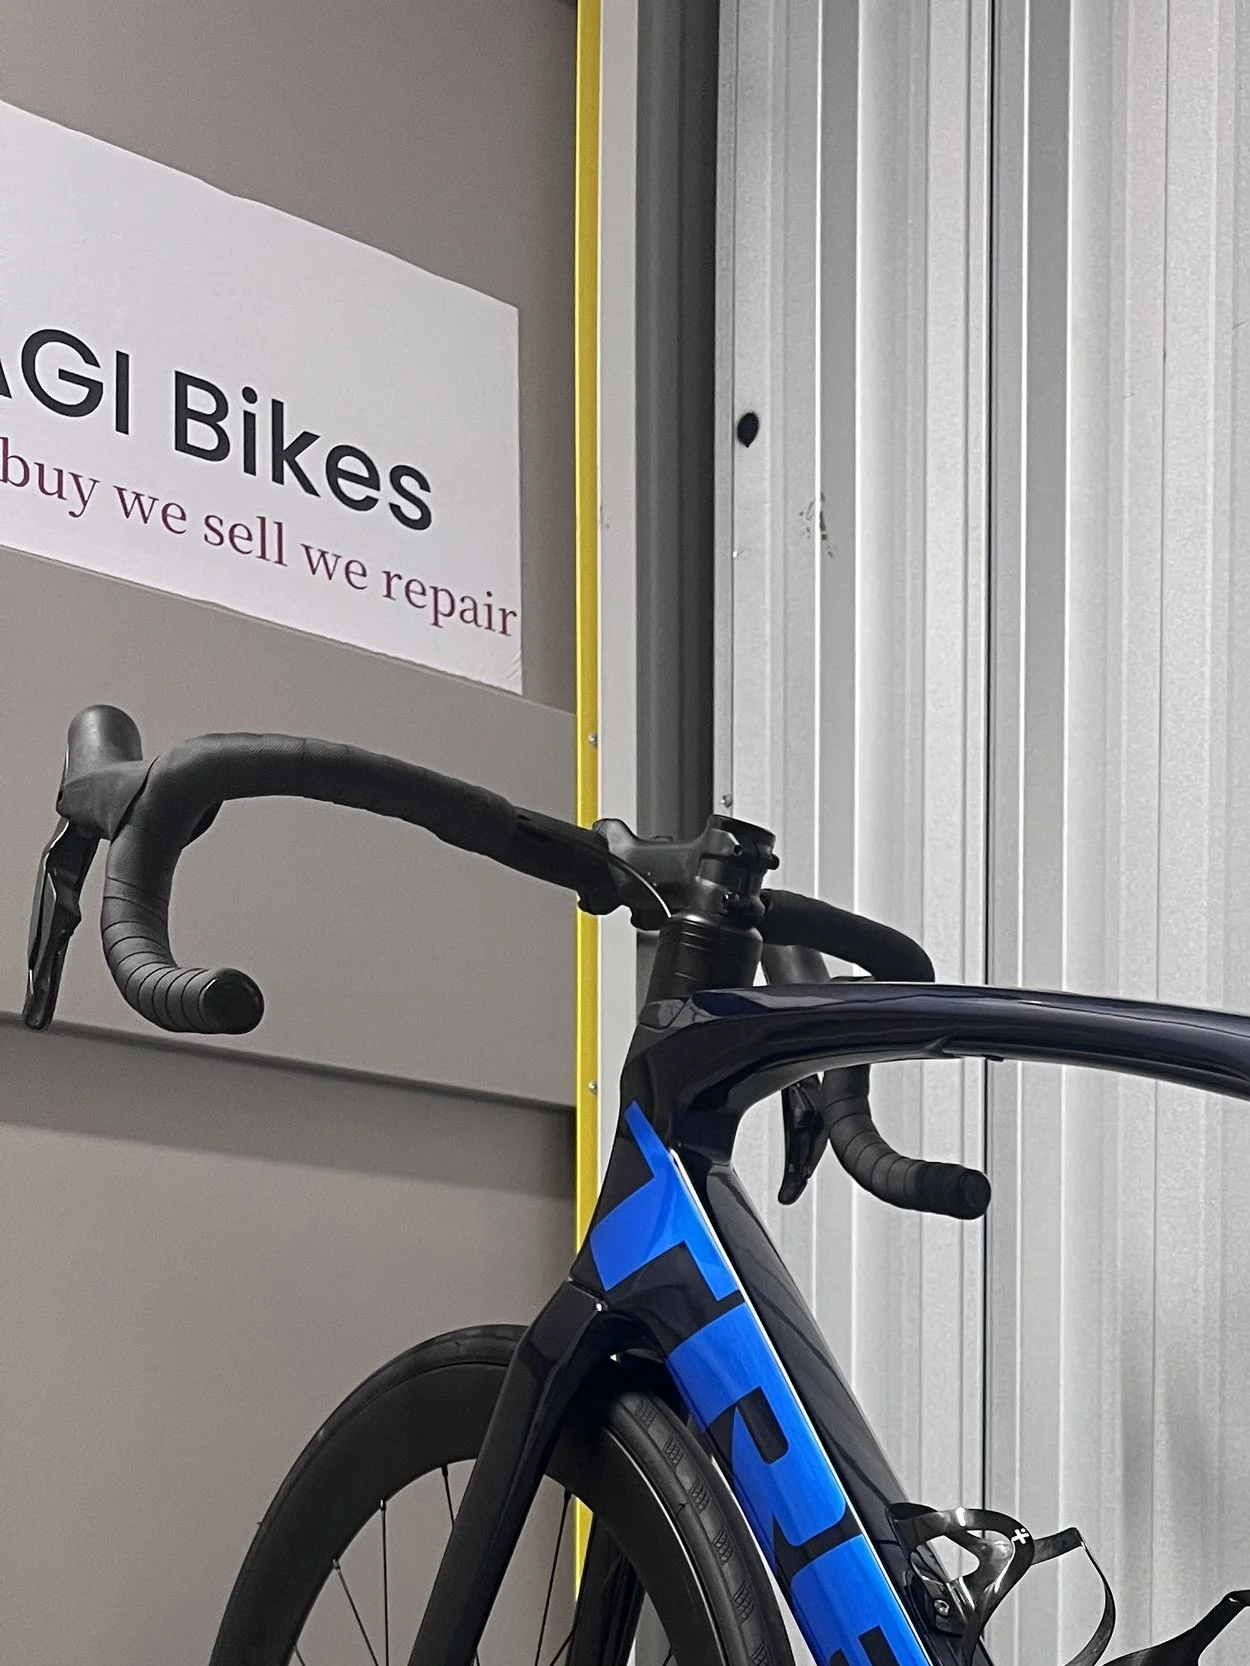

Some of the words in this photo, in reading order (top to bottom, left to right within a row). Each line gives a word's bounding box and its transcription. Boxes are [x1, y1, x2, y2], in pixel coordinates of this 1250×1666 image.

[0, 328, 130, 436] GI
[174, 369, 432, 531] Bikes
[0, 436, 100, 518] buy
[113, 485, 187, 535] we
[203, 514, 288, 567] sell
[300, 543, 367, 590] we
[382, 571, 517, 636] repair
